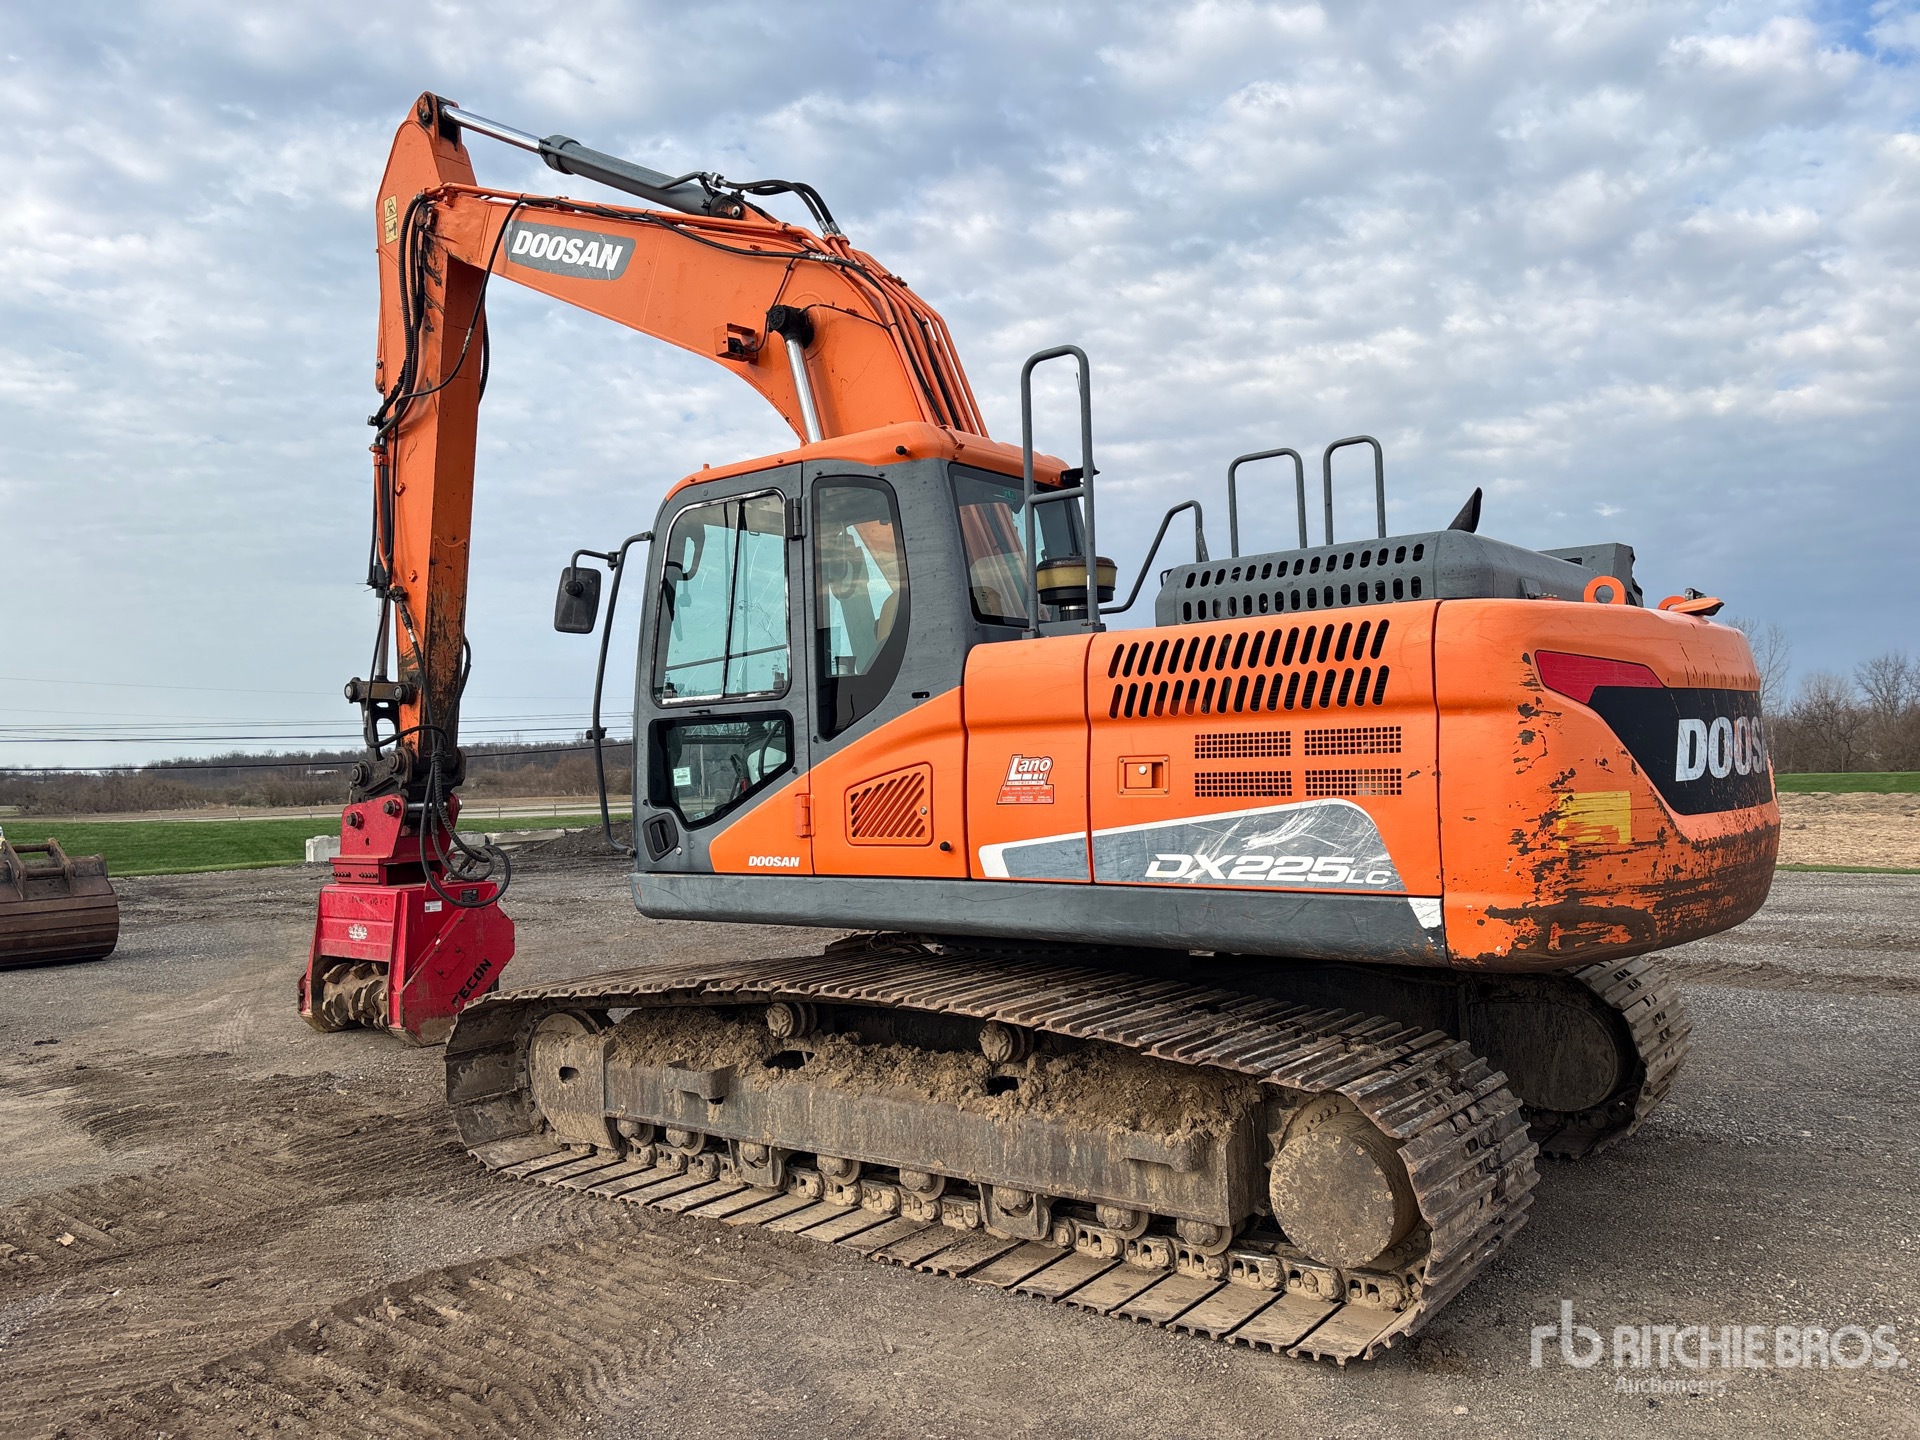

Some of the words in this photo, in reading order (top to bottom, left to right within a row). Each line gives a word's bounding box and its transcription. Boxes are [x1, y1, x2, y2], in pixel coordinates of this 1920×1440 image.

[511, 229, 624, 271] DOOSAN
[1008, 756, 1051, 781] Lano
[748, 855, 800, 868] DOOSAN
[451, 958, 493, 1010] FECON
